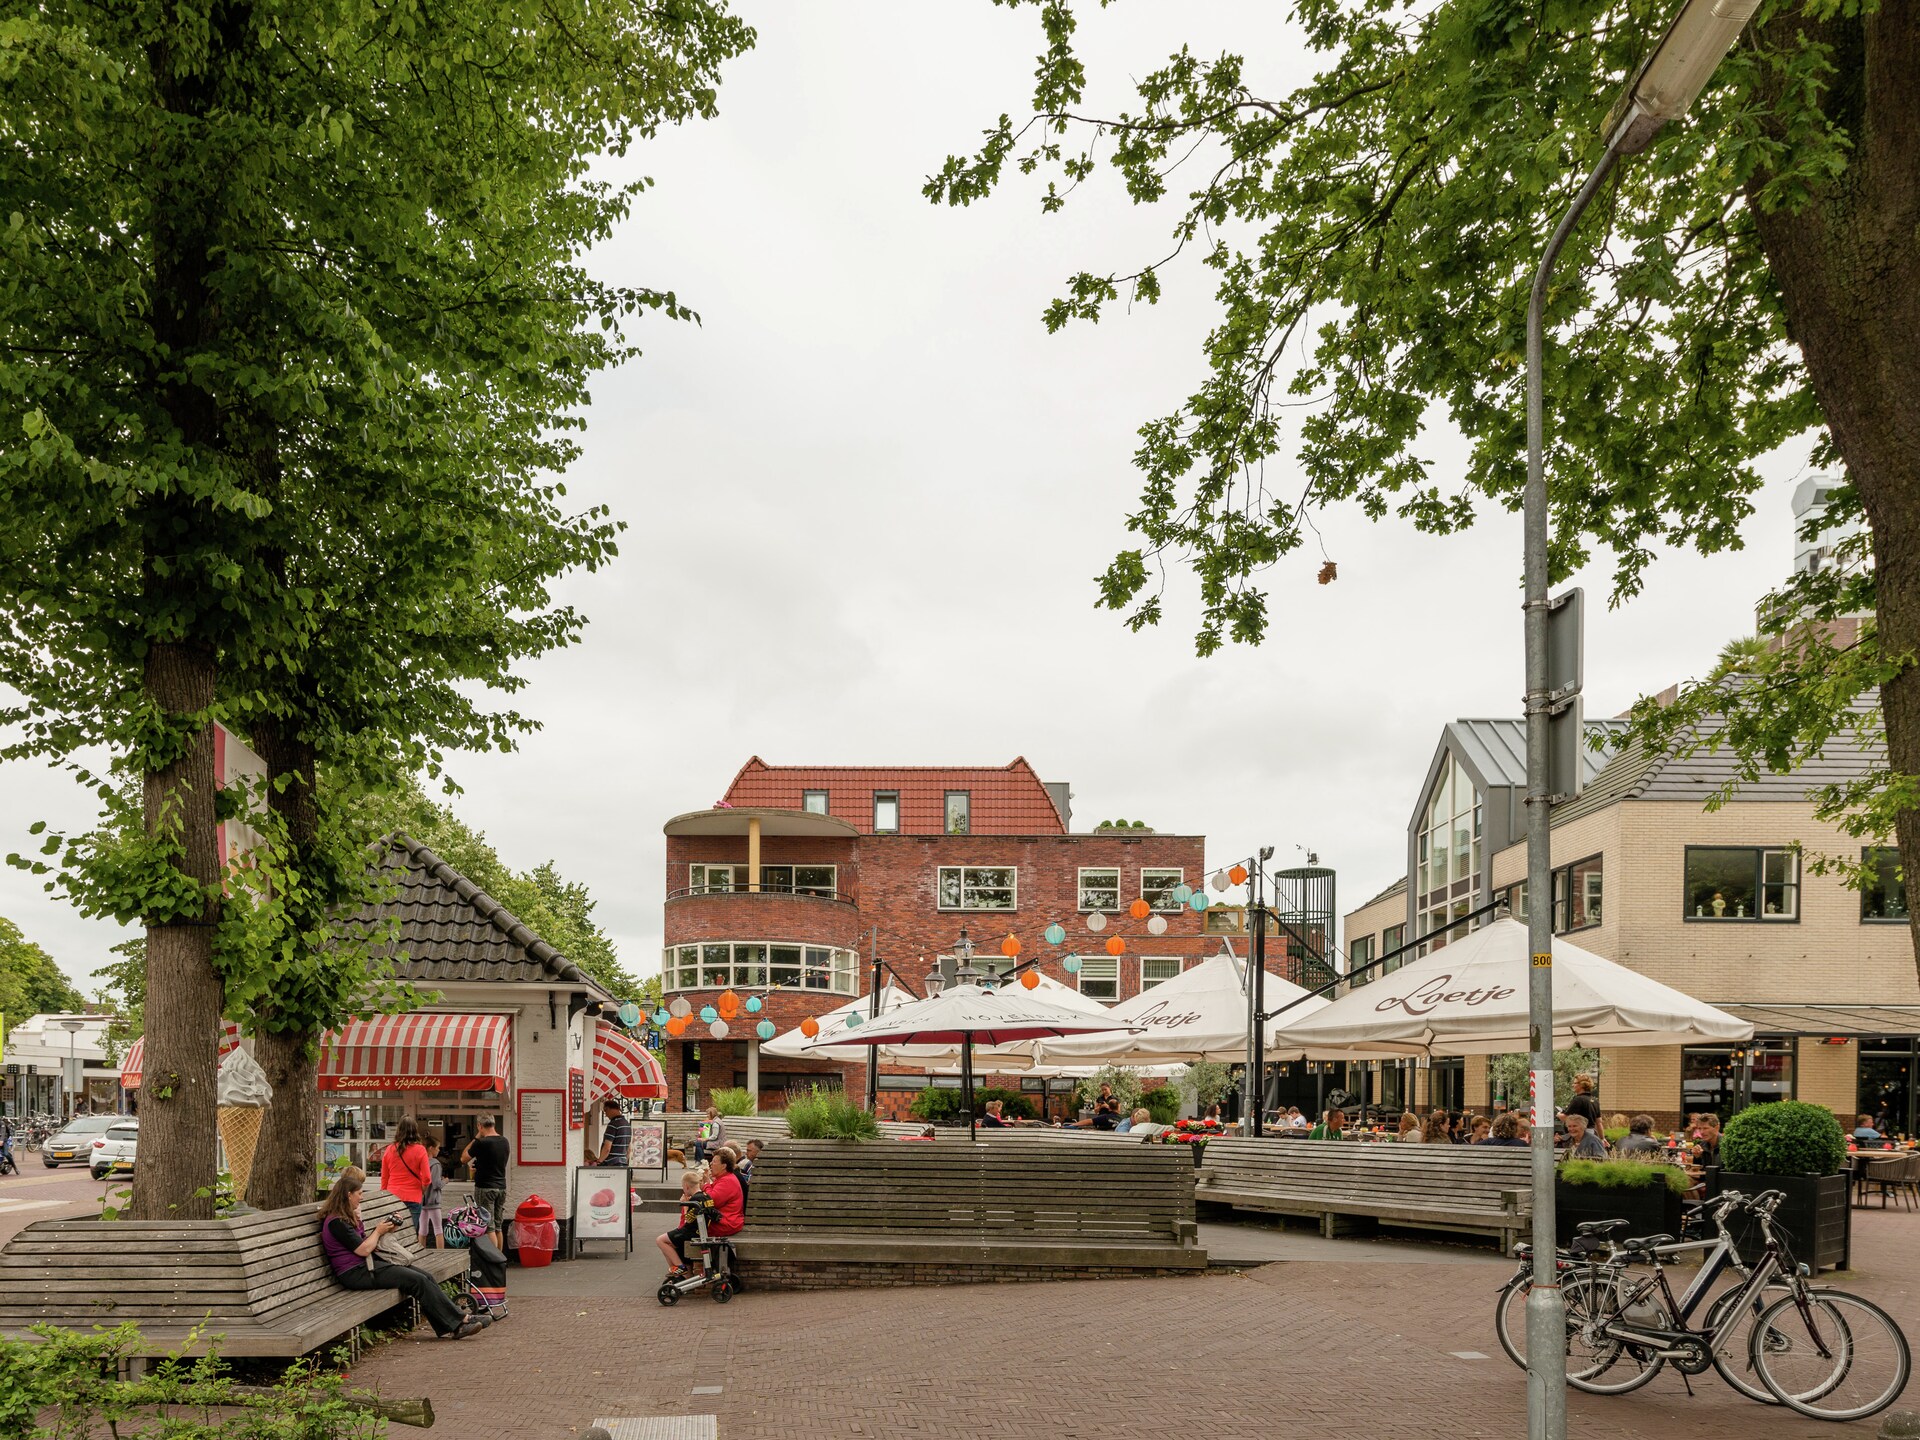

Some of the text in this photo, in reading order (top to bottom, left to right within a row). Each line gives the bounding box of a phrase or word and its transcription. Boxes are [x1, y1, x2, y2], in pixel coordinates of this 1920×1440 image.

[1375, 974, 1516, 1016] Loetje
[1121, 1000, 1202, 1036] Loetje
[336, 1076, 441, 1090] Sandra's ijspaleis
